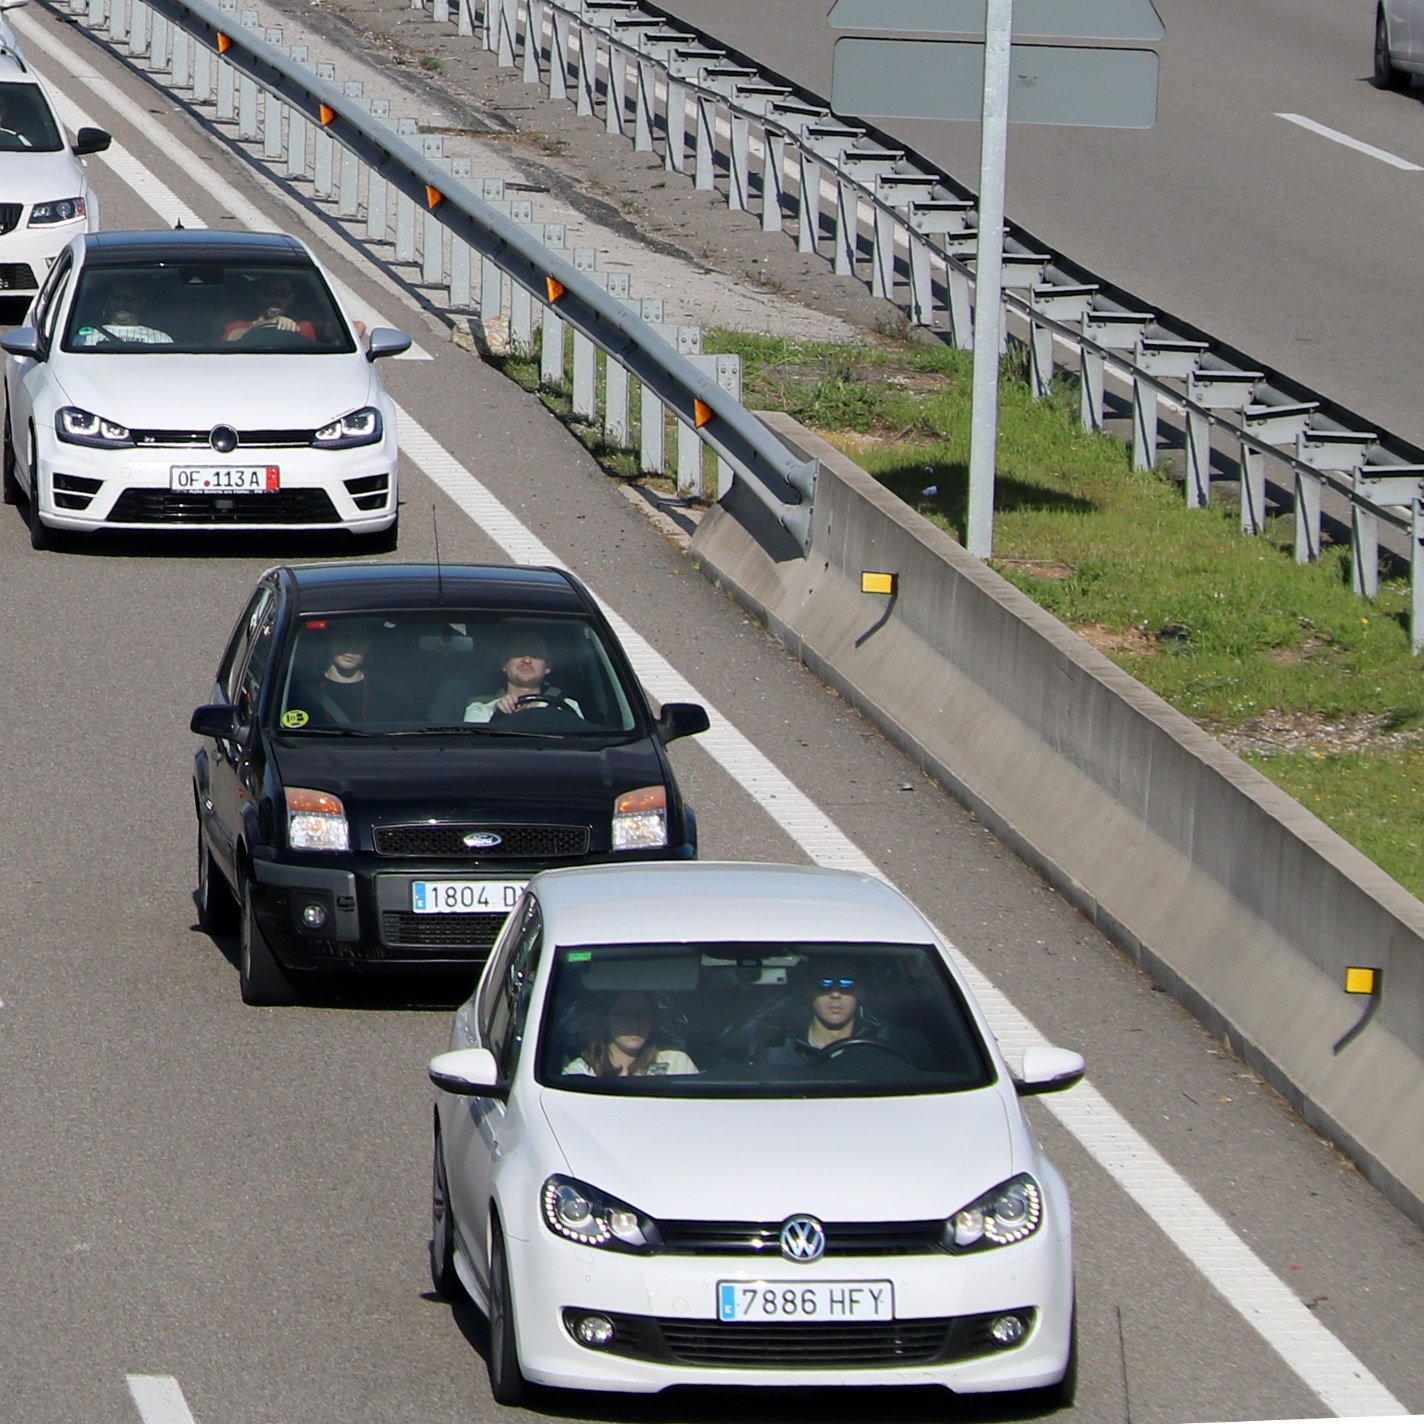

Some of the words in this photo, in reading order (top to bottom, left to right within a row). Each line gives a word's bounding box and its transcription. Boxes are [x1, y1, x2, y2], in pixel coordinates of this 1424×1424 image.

[177, 470, 200, 487] OF
[212, 470, 245, 487] 113
[249, 470, 260, 487] A
[432, 886, 490, 908] 1804
[742, 1288, 817, 1316] 7886
[829, 1287, 883, 1315] HFY
